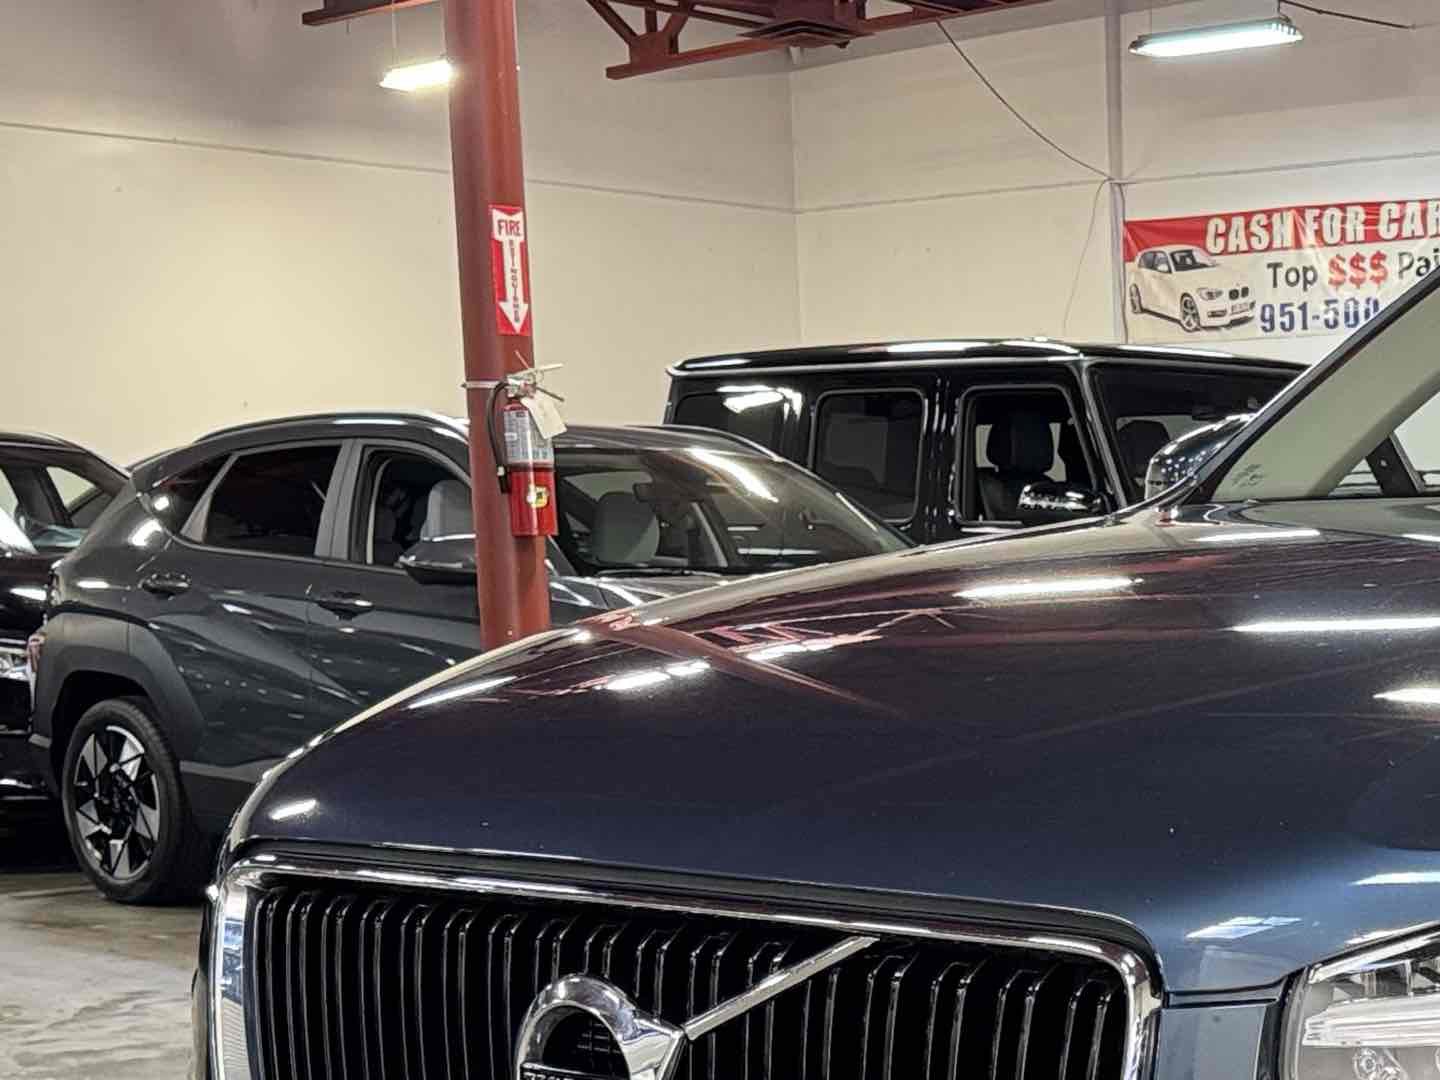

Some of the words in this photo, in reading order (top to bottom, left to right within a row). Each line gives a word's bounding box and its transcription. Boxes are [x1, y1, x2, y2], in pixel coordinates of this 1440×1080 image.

[497, 219, 522, 237] FIRE
[1205, 211, 1295, 254] CASH
[1303, 204, 1366, 248] FOR
[1266, 262, 1319, 292] Top
[1327, 250, 1388, 289] $$$
